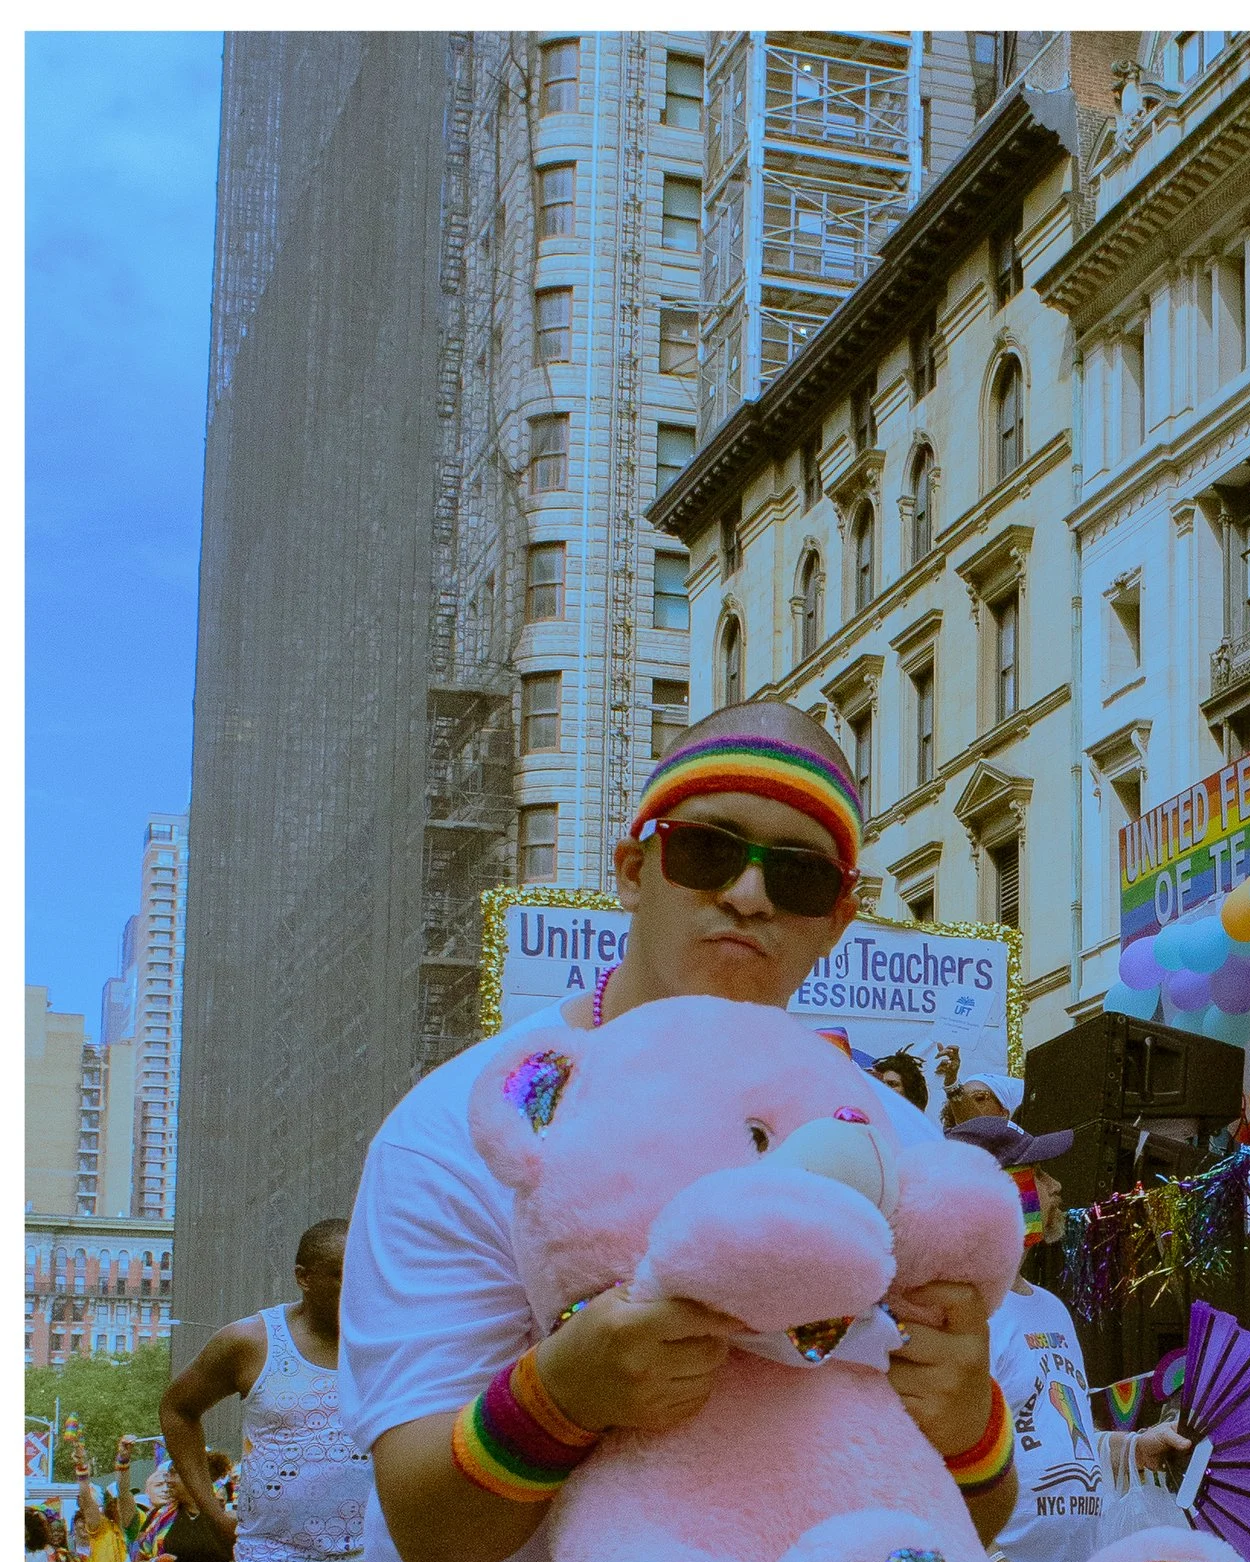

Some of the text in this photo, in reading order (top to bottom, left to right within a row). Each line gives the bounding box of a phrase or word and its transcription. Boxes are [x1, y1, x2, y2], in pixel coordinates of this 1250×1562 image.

[1122, 781, 1210, 884] UNITED
[1153, 857, 1193, 928] OF
[835, 941, 852, 979] of
[854, 937, 994, 990] Teachers
[797, 980, 936, 1014] ESSIONALS
[1036, 1496, 1066, 1516] NYC
